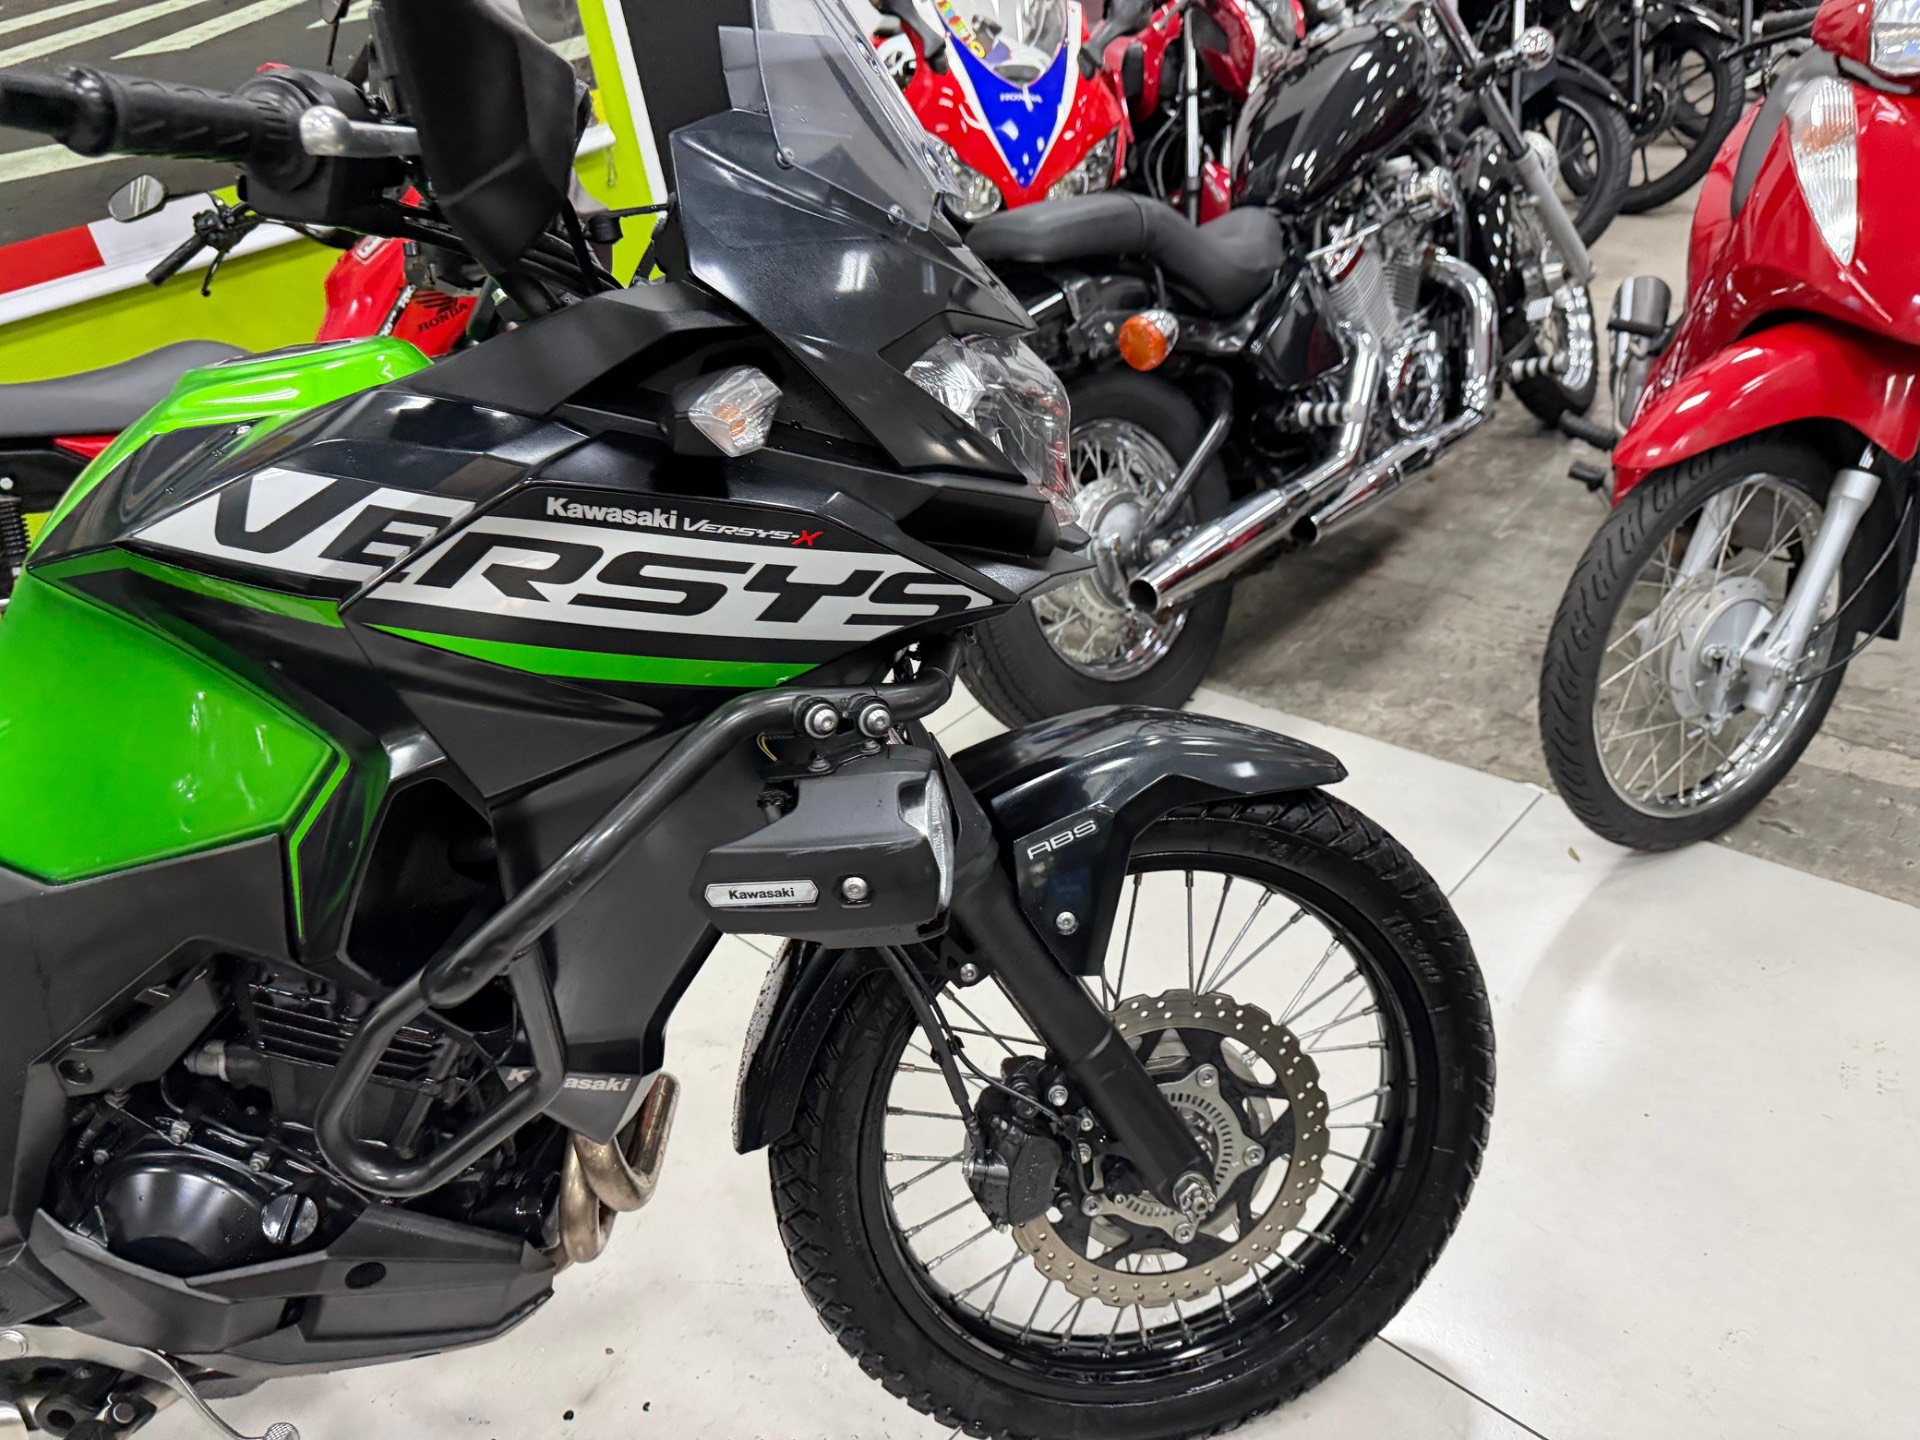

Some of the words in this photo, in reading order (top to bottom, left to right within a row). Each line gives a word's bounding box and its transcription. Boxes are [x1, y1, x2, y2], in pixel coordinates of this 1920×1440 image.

[417, 302, 469, 333] HONDA
[546, 497, 677, 530] Kawasaki
[683, 519, 823, 546] VERSYS-X
[214, 477, 973, 627] VERSYS
[1027, 819, 1097, 860] ABS
[728, 887, 795, 900] Kawasaki
[507, 1068, 631, 1091] Kasaki
